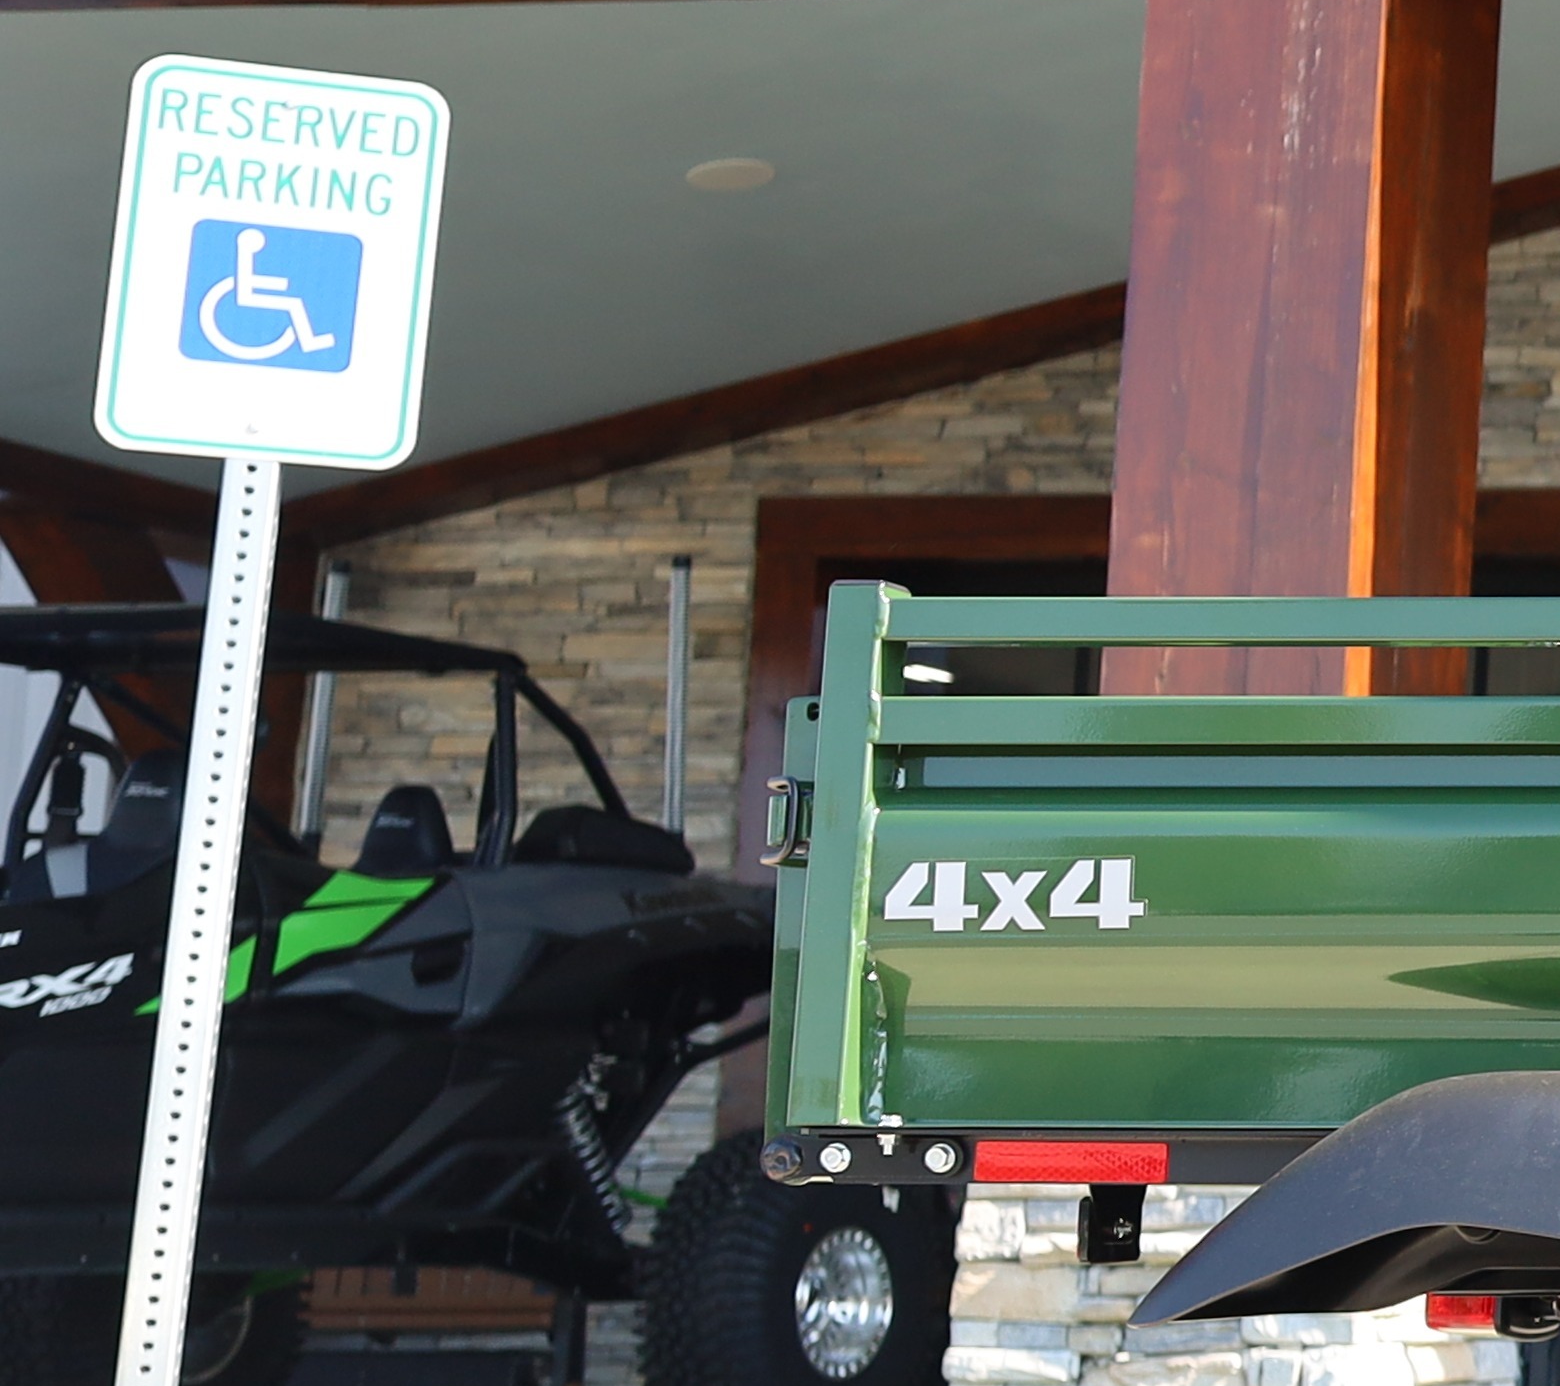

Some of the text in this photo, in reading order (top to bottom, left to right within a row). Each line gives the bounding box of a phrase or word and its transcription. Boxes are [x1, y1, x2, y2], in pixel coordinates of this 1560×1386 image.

[157, 88, 420, 157] RESERVED
[172, 152, 393, 216] PARKING
[883, 858, 1147, 933] 4x4
